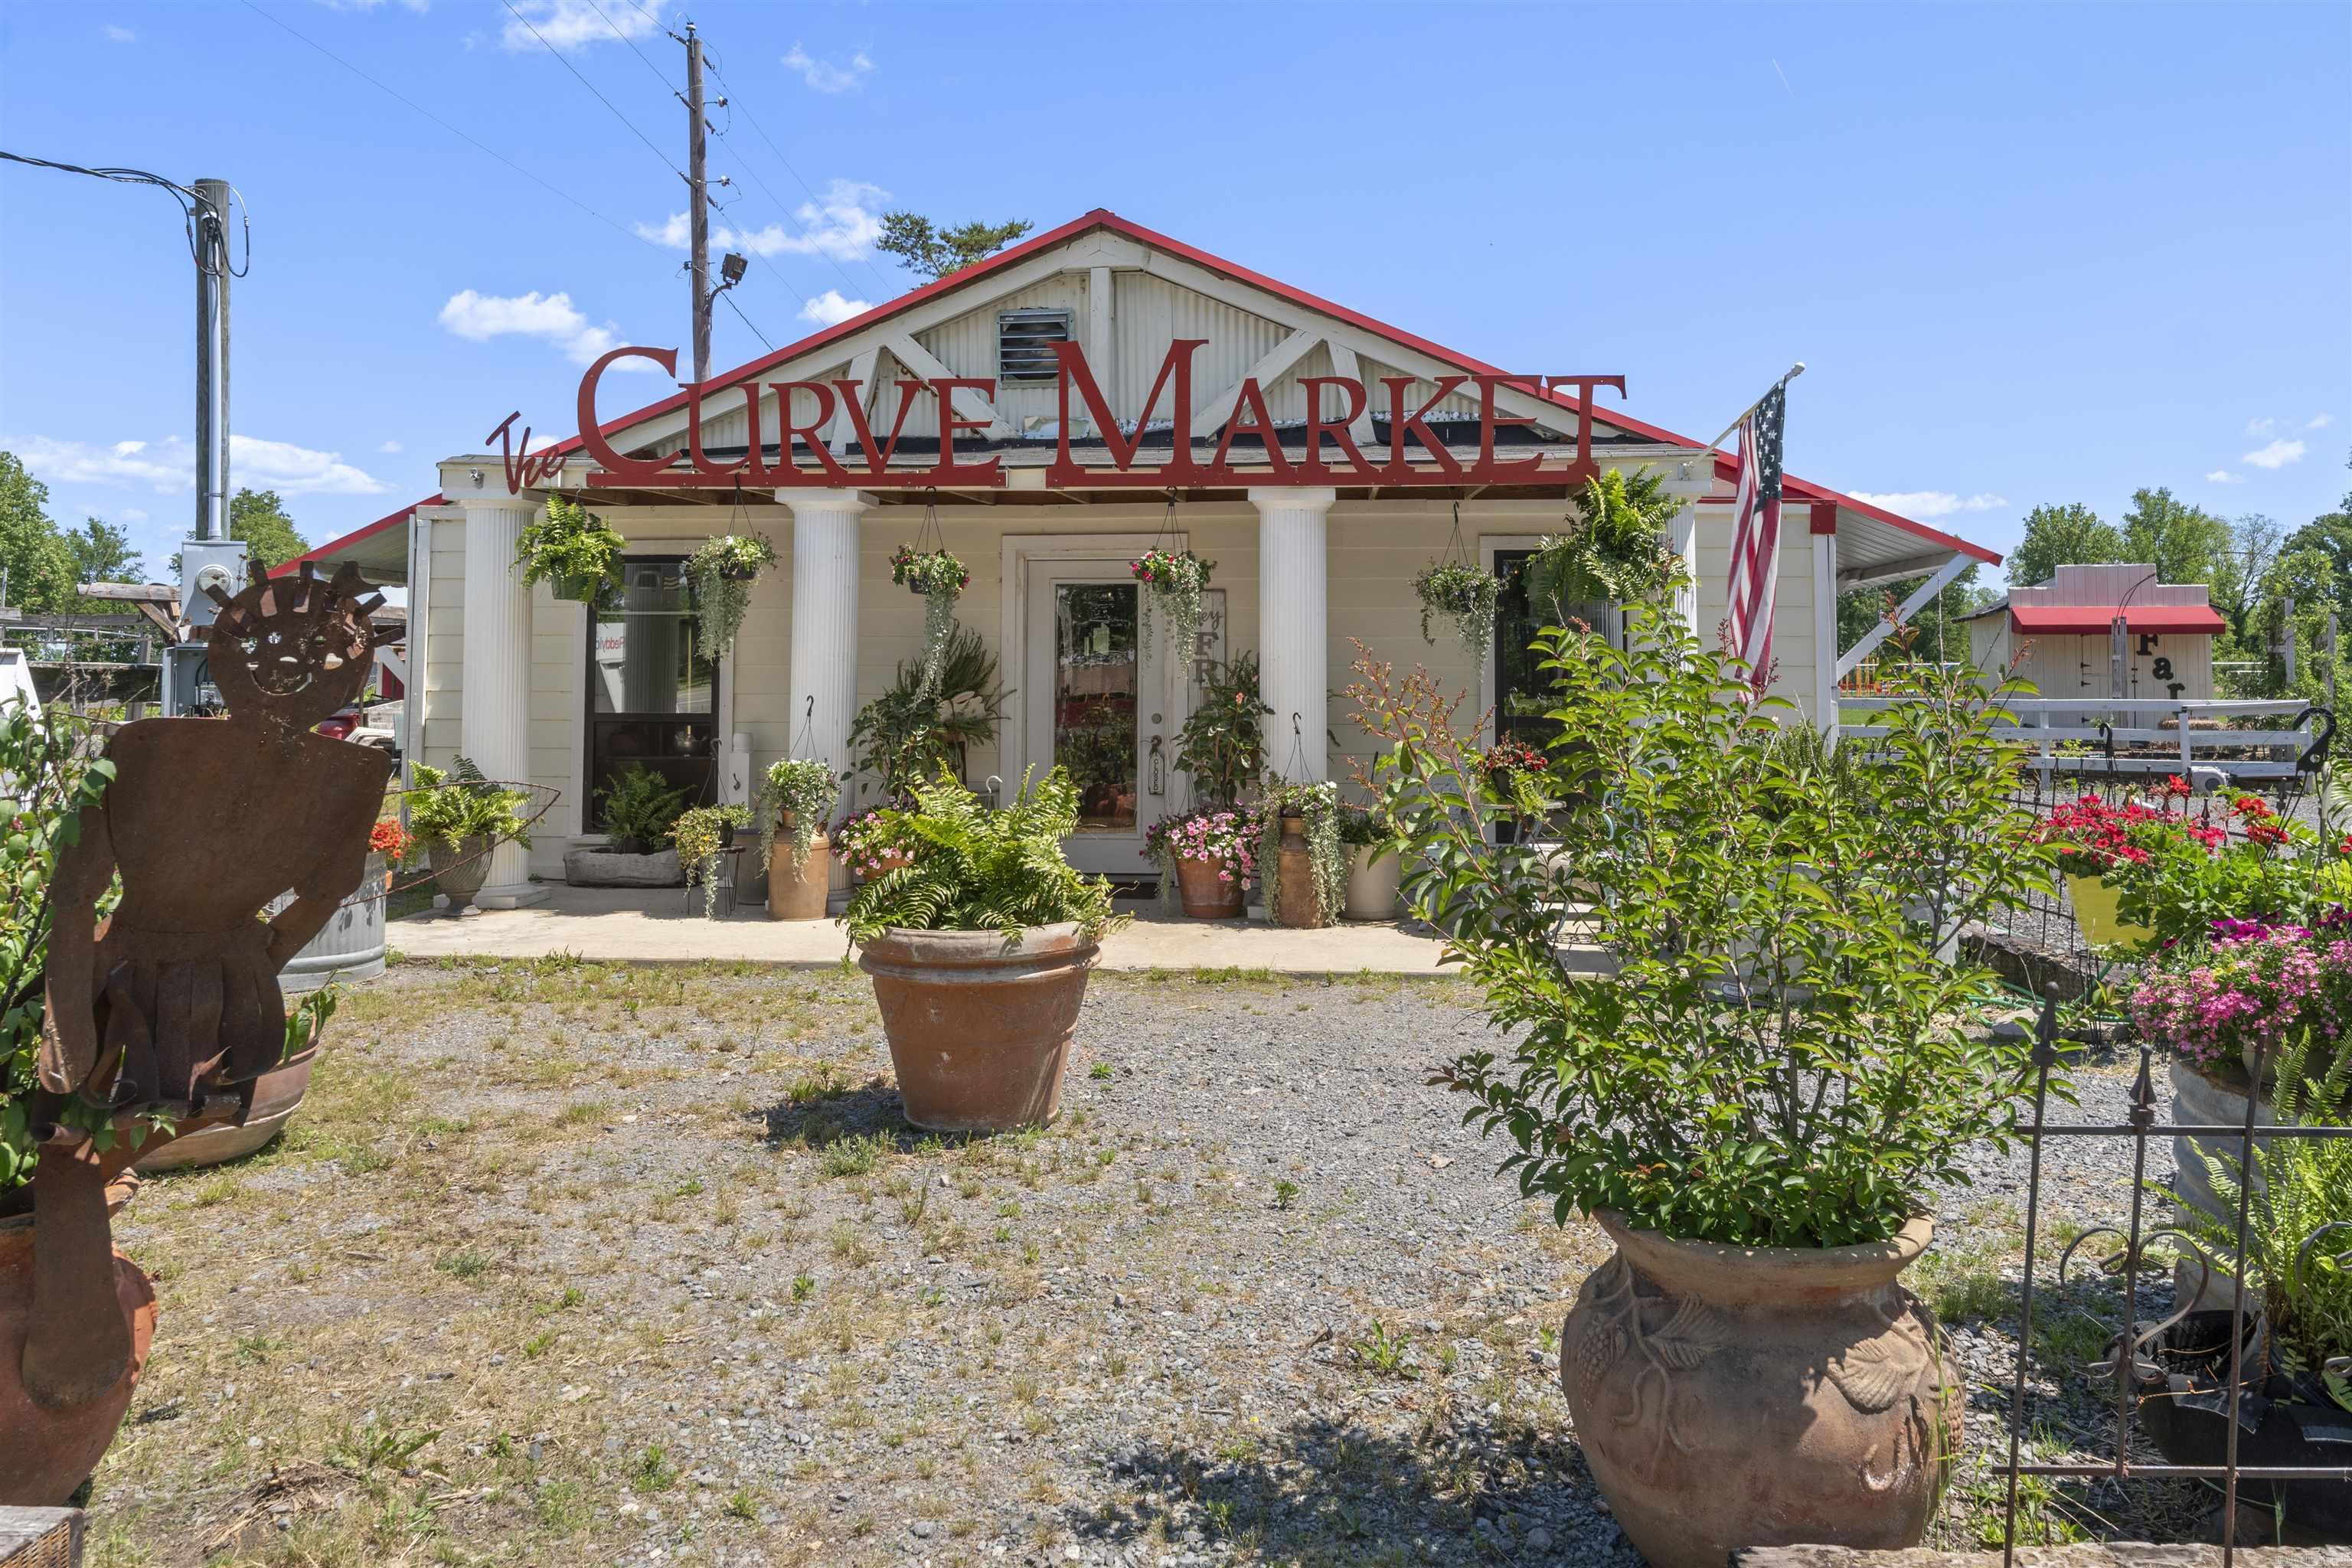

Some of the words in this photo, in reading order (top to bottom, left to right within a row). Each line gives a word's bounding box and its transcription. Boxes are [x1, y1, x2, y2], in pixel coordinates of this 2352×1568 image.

[485, 410, 567, 495] The
[577, 345, 1002, 476] CURVE
[1046, 338, 1627, 475] MARKET
